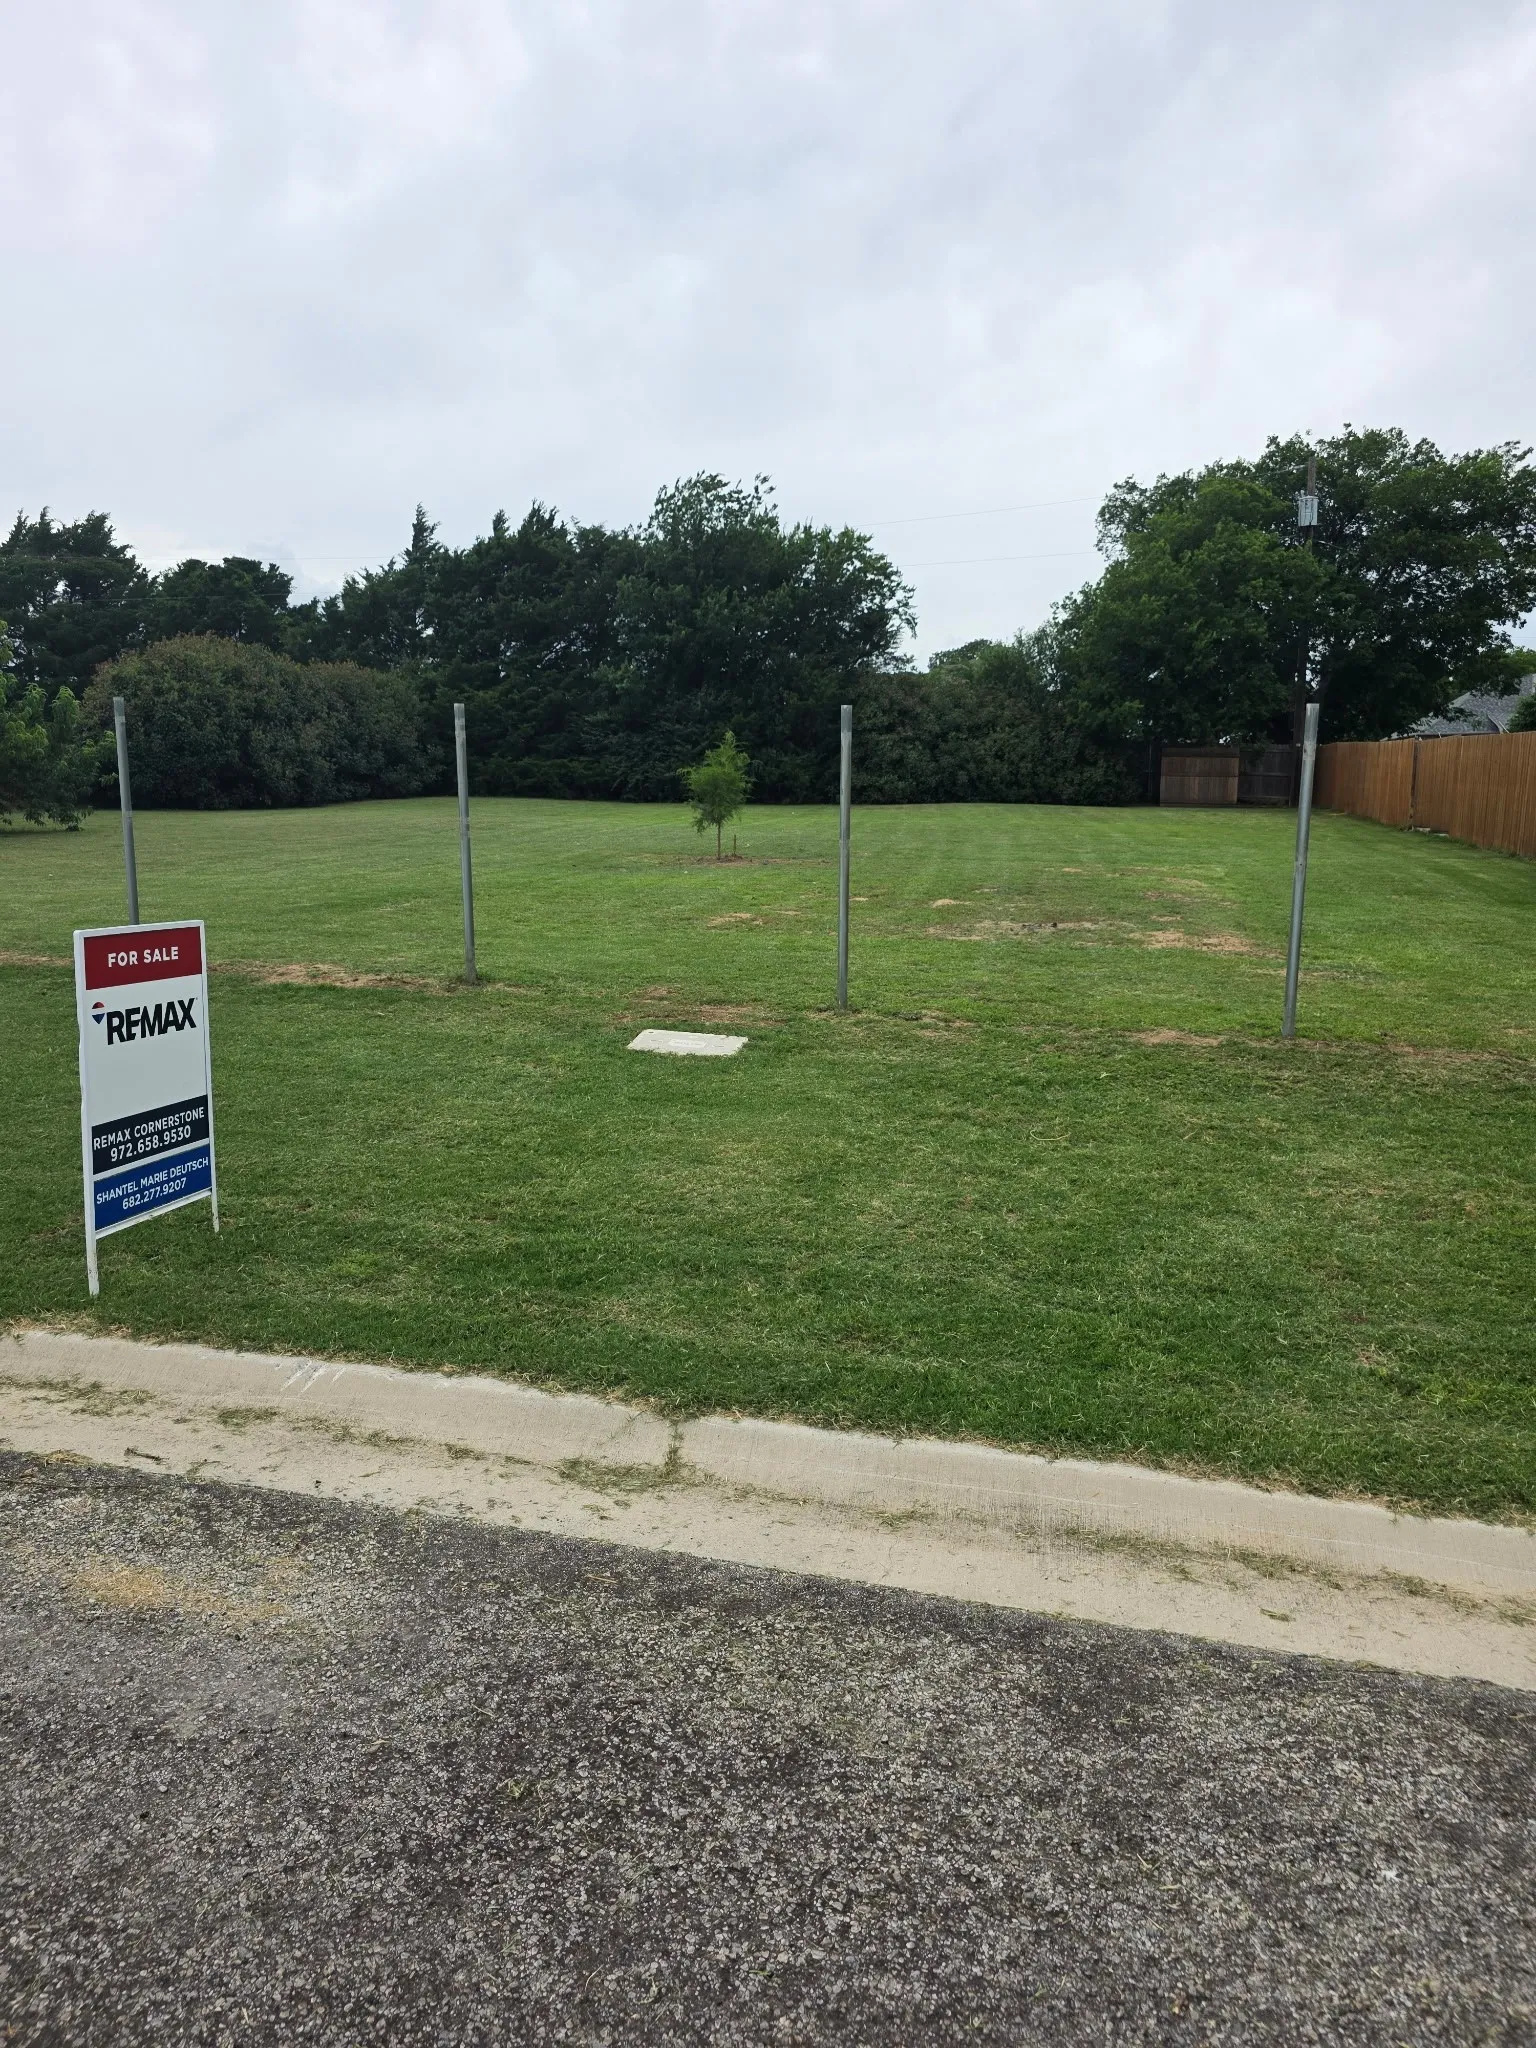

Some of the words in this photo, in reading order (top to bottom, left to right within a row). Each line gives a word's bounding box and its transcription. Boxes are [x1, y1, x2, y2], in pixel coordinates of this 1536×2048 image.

[108, 951, 138, 967] FOR
[143, 946, 179, 963] SALE
[93, 1128, 131, 1150] REMAX
[134, 1106, 205, 1138] CORNERSTONE
[110, 1125, 191, 1162] 972.658.9530
[96, 1181, 138, 1204] SHANTEL
[140, 1170, 168, 1189] MARIE
[170, 1157, 209, 1178] DEUTSCH
[122, 1178, 187, 1210] 682.277.9207
